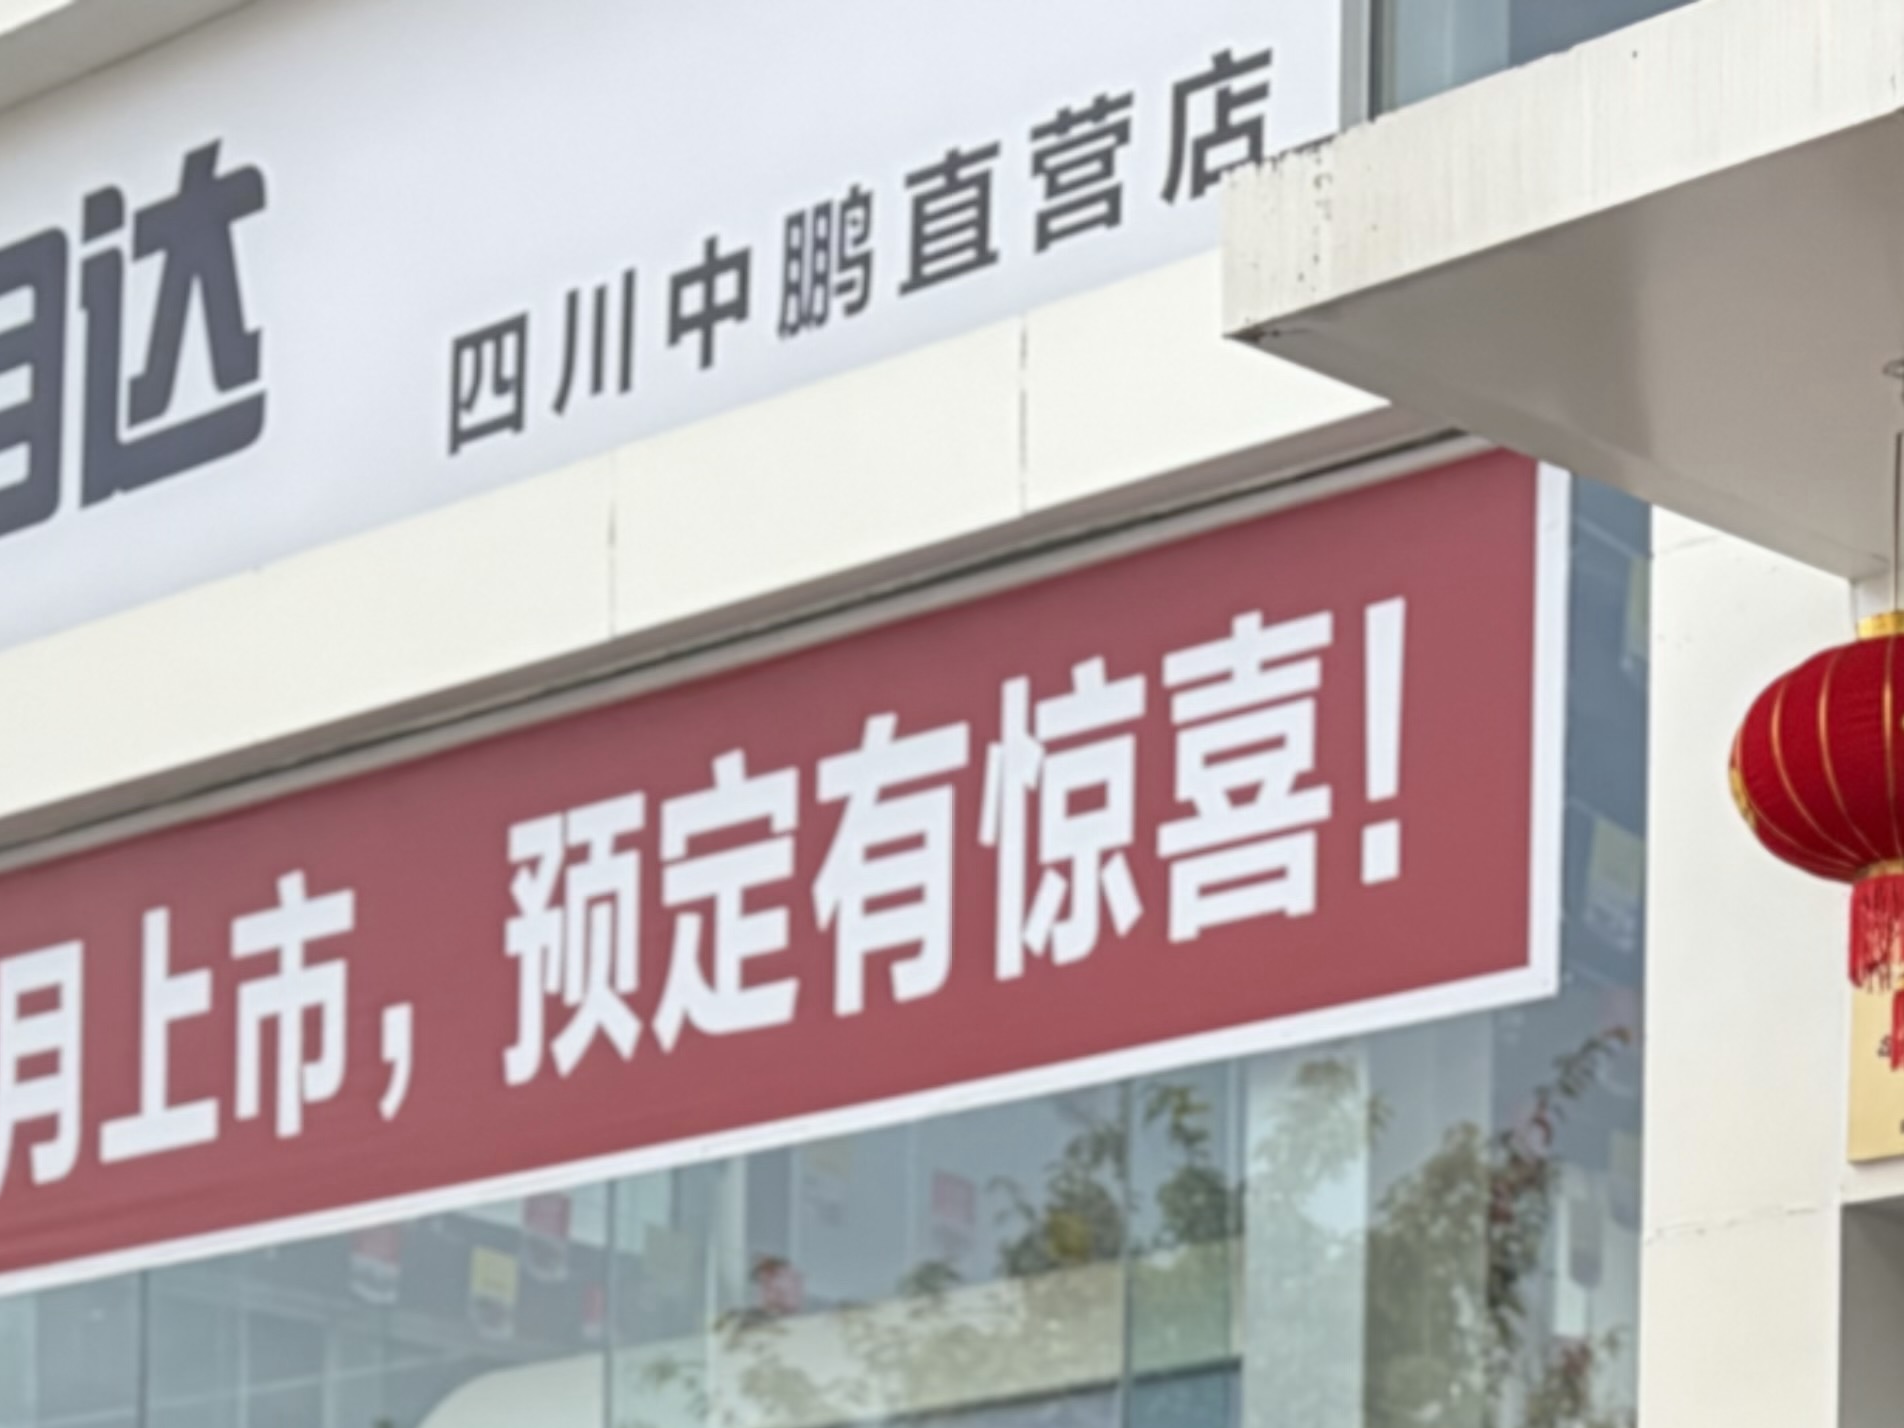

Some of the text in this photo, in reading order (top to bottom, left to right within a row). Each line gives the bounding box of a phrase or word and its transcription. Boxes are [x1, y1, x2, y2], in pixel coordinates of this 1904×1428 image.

[447, 46, 1274, 456] 四川中鹏直营店
